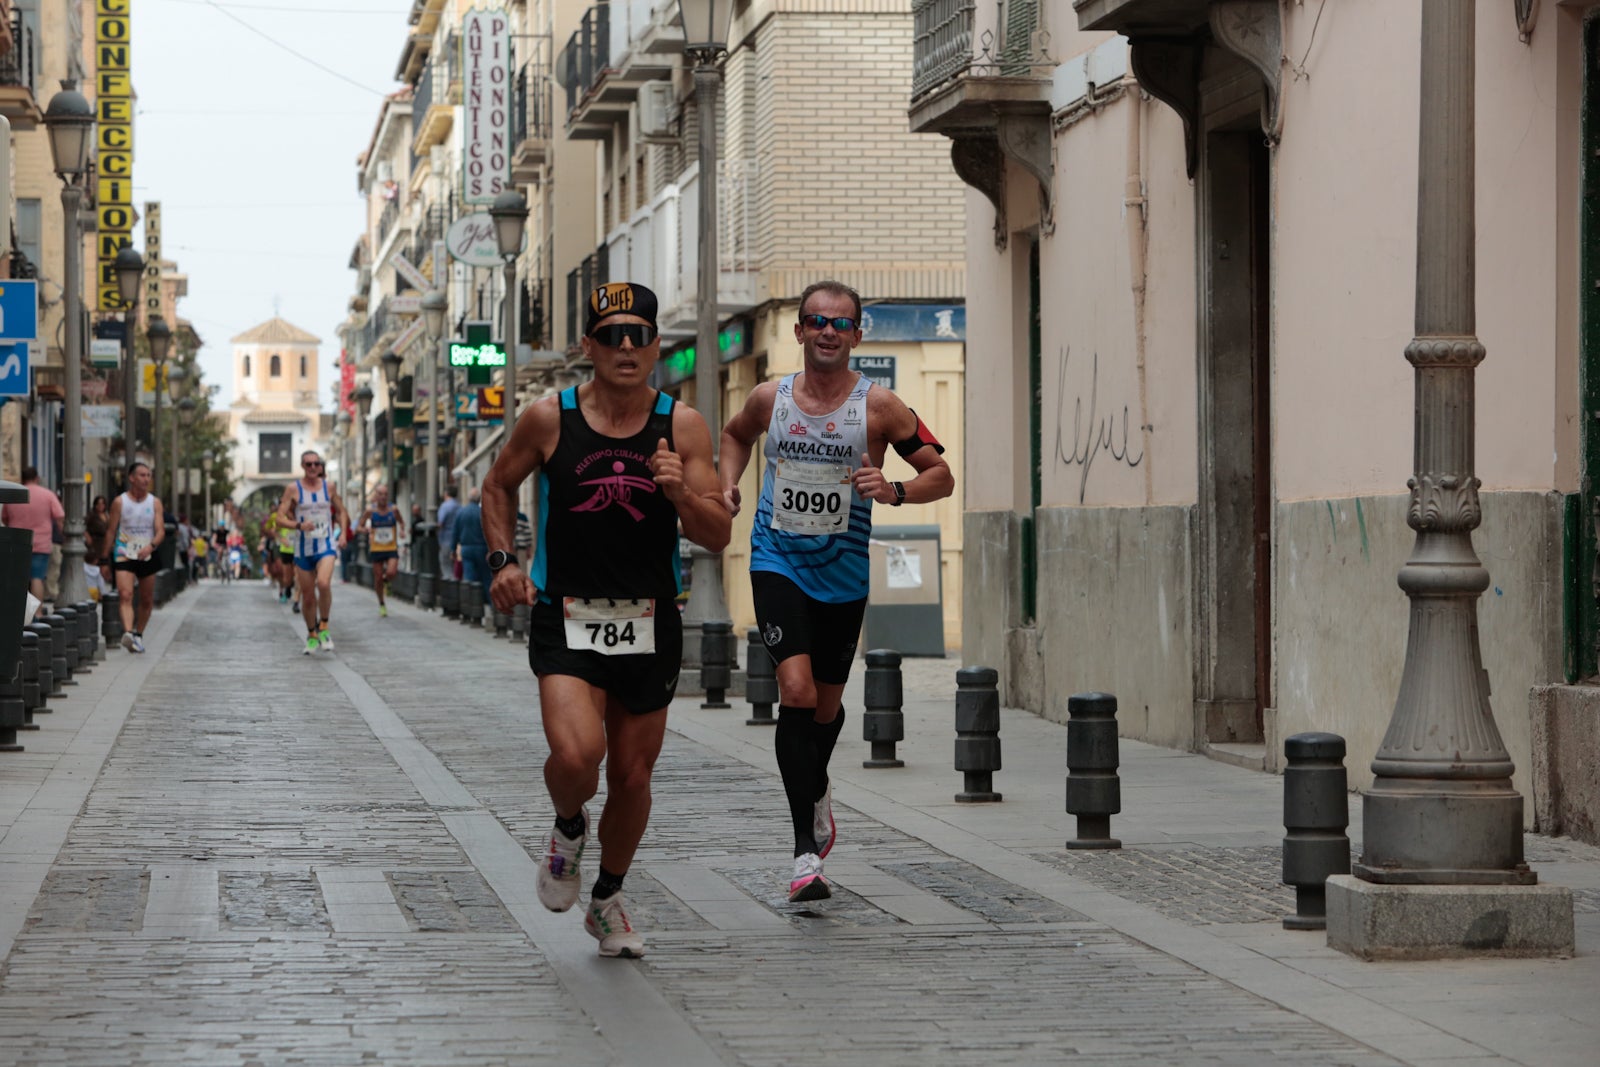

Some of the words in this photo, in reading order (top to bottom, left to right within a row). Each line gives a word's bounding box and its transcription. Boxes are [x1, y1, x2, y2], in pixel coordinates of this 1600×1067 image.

[469, 17, 484, 196] AUTENTICOS
[490, 19, 505, 194] PIONONOS
[101, 0, 129, 309] CONFECCIONES
[859, 358, 892, 368] CALLE
[575, 449, 612, 475] ATLETISMO
[777, 440, 852, 457] MARACENA
[781, 487, 841, 514] 3090
[585, 621, 636, 648] 784
